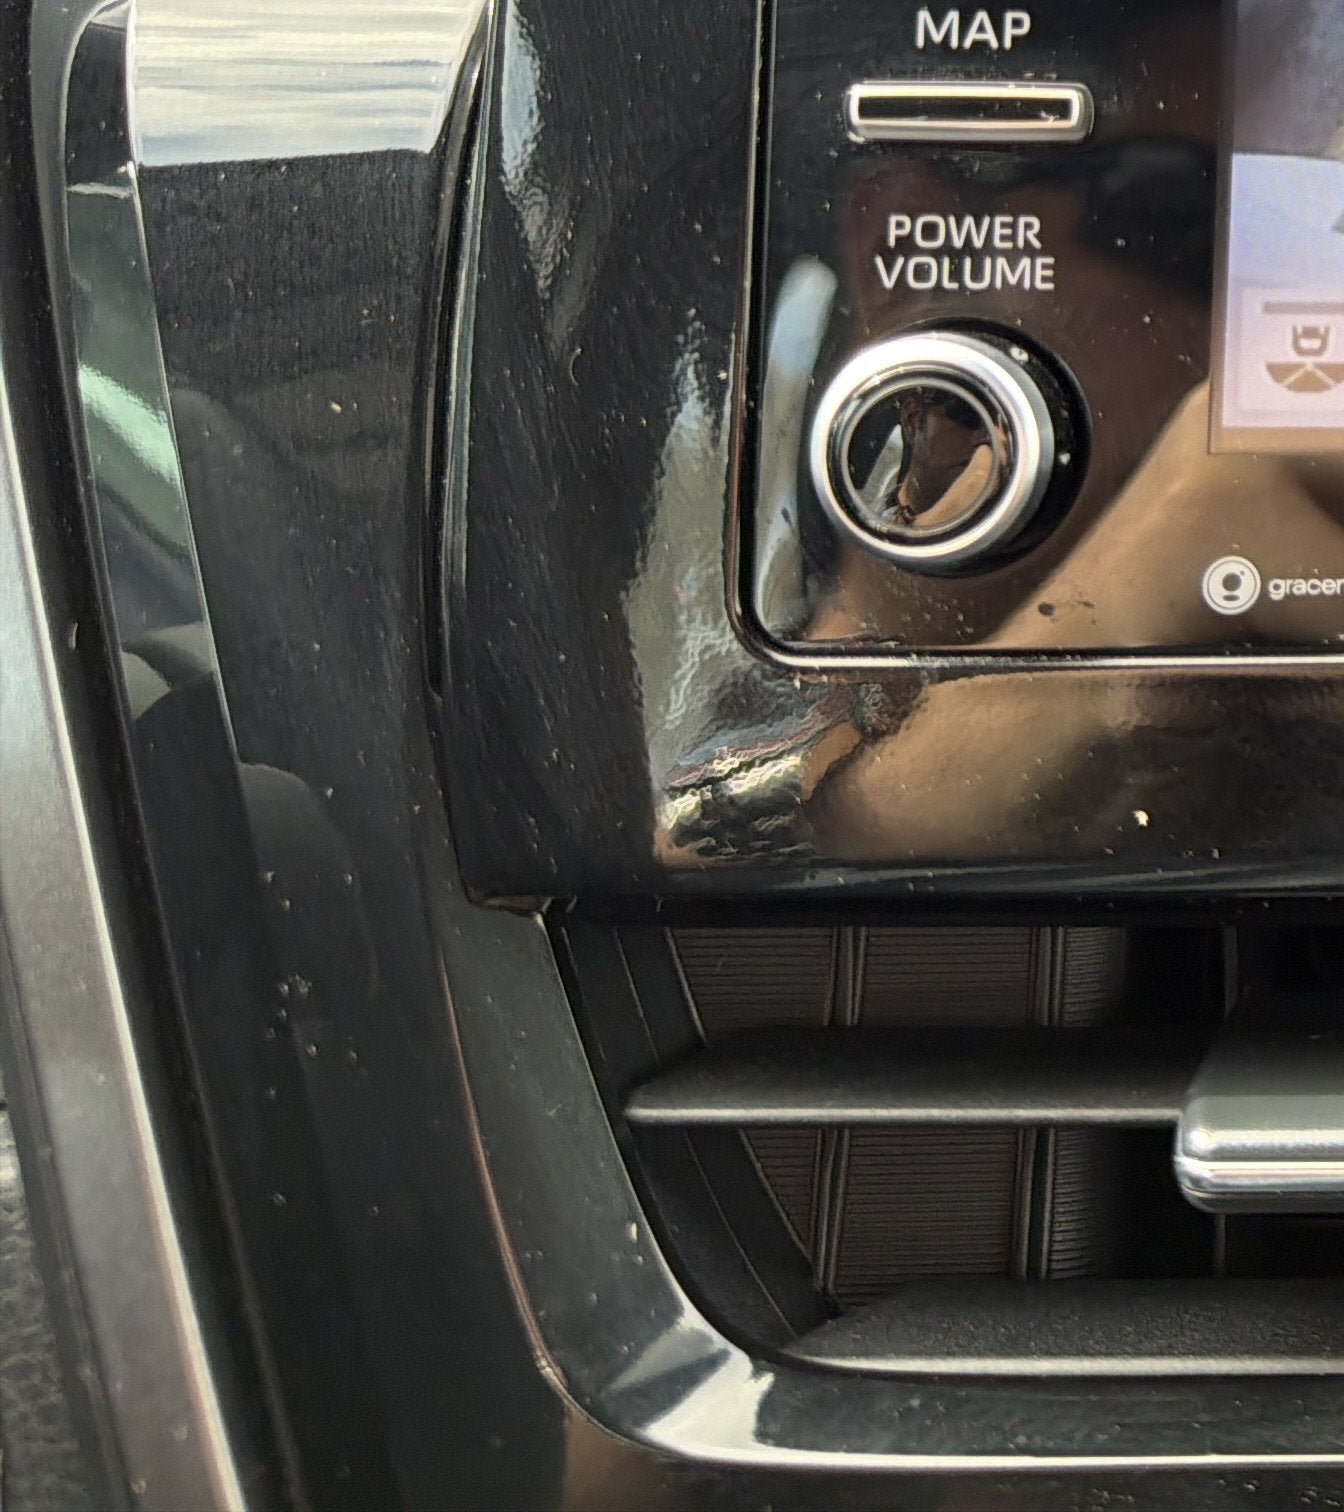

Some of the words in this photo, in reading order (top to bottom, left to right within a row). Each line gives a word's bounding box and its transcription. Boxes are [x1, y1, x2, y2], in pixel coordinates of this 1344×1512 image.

[915, 9, 1031, 50] MAP
[887, 214, 1042, 250] POWER
[874, 255, 1055, 290] VOLUME
